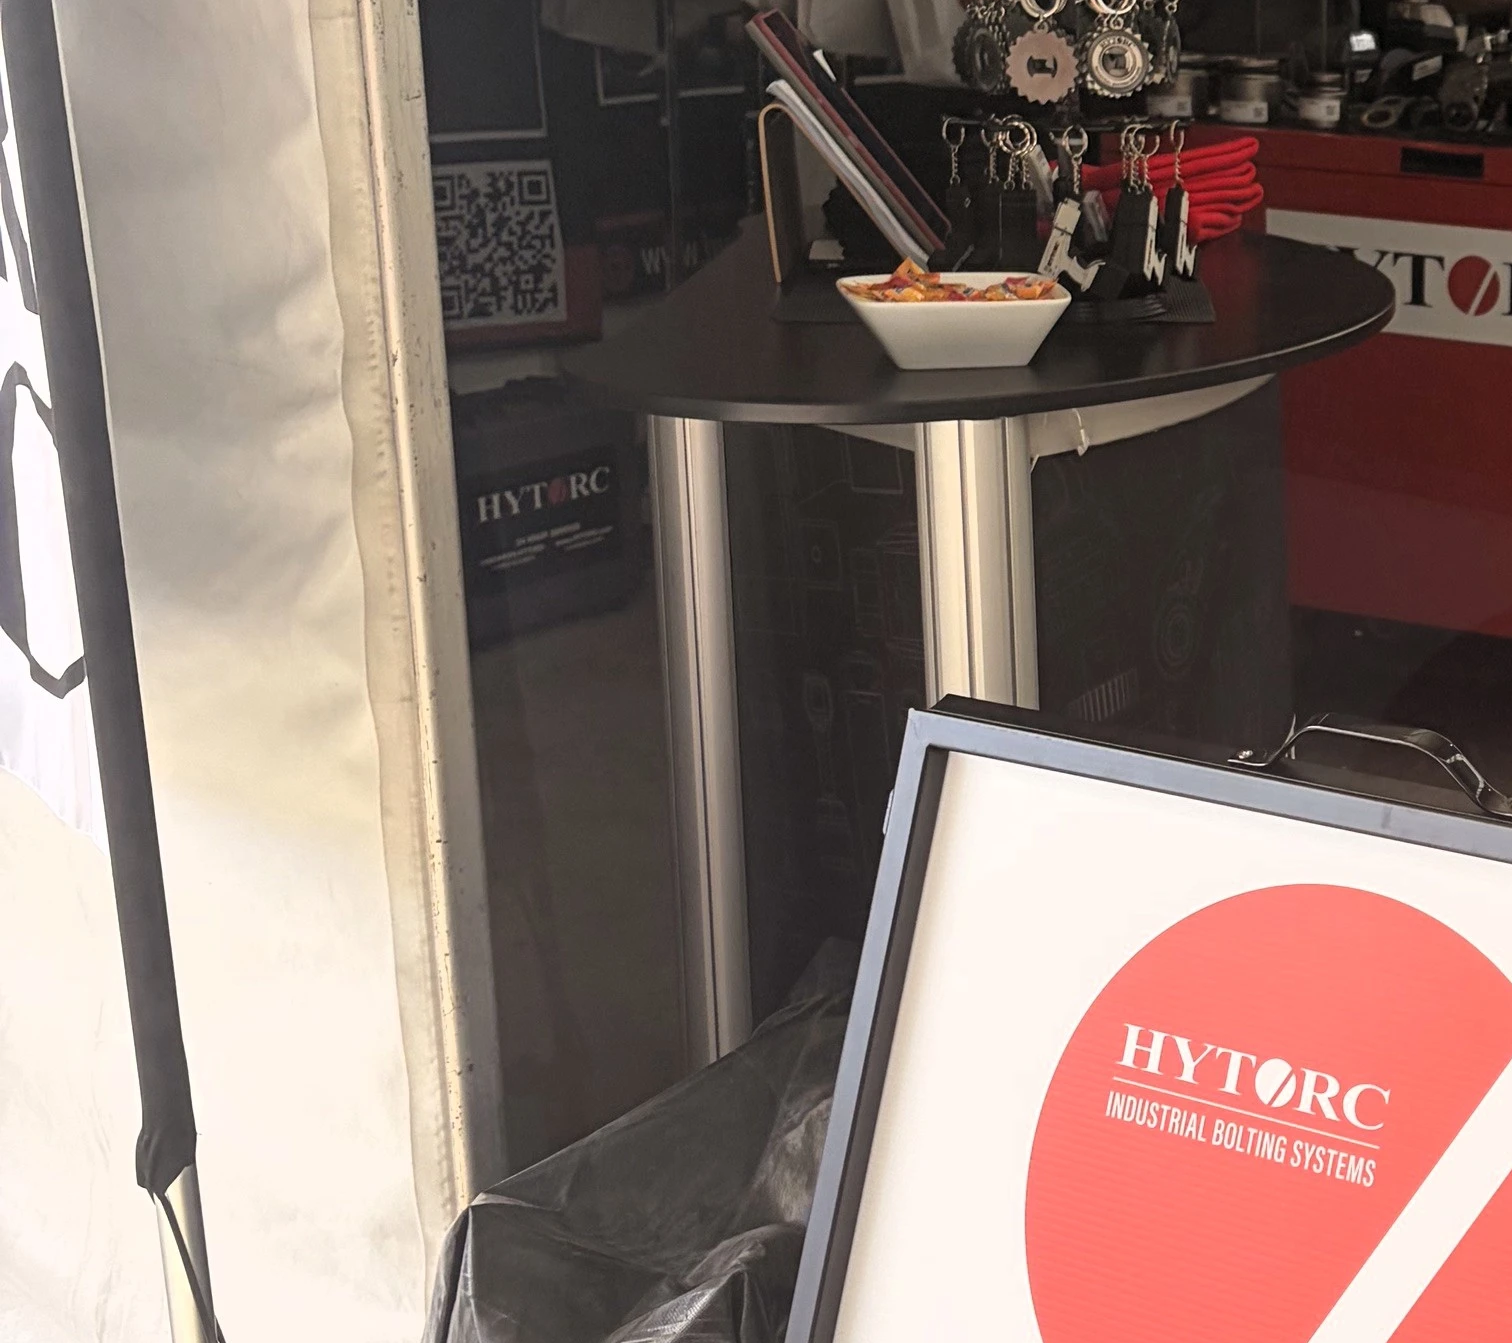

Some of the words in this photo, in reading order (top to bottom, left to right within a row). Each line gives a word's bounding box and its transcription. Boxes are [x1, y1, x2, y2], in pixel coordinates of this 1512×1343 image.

[477, 466, 611, 523] HYTORC
[1115, 1021, 1393, 1132] HYTORC
[1105, 1089, 1207, 1143] INDUSTRIAL
[1211, 1118, 1288, 1166] BOLTING
[1290, 1138, 1378, 1188] SYSTEMS
